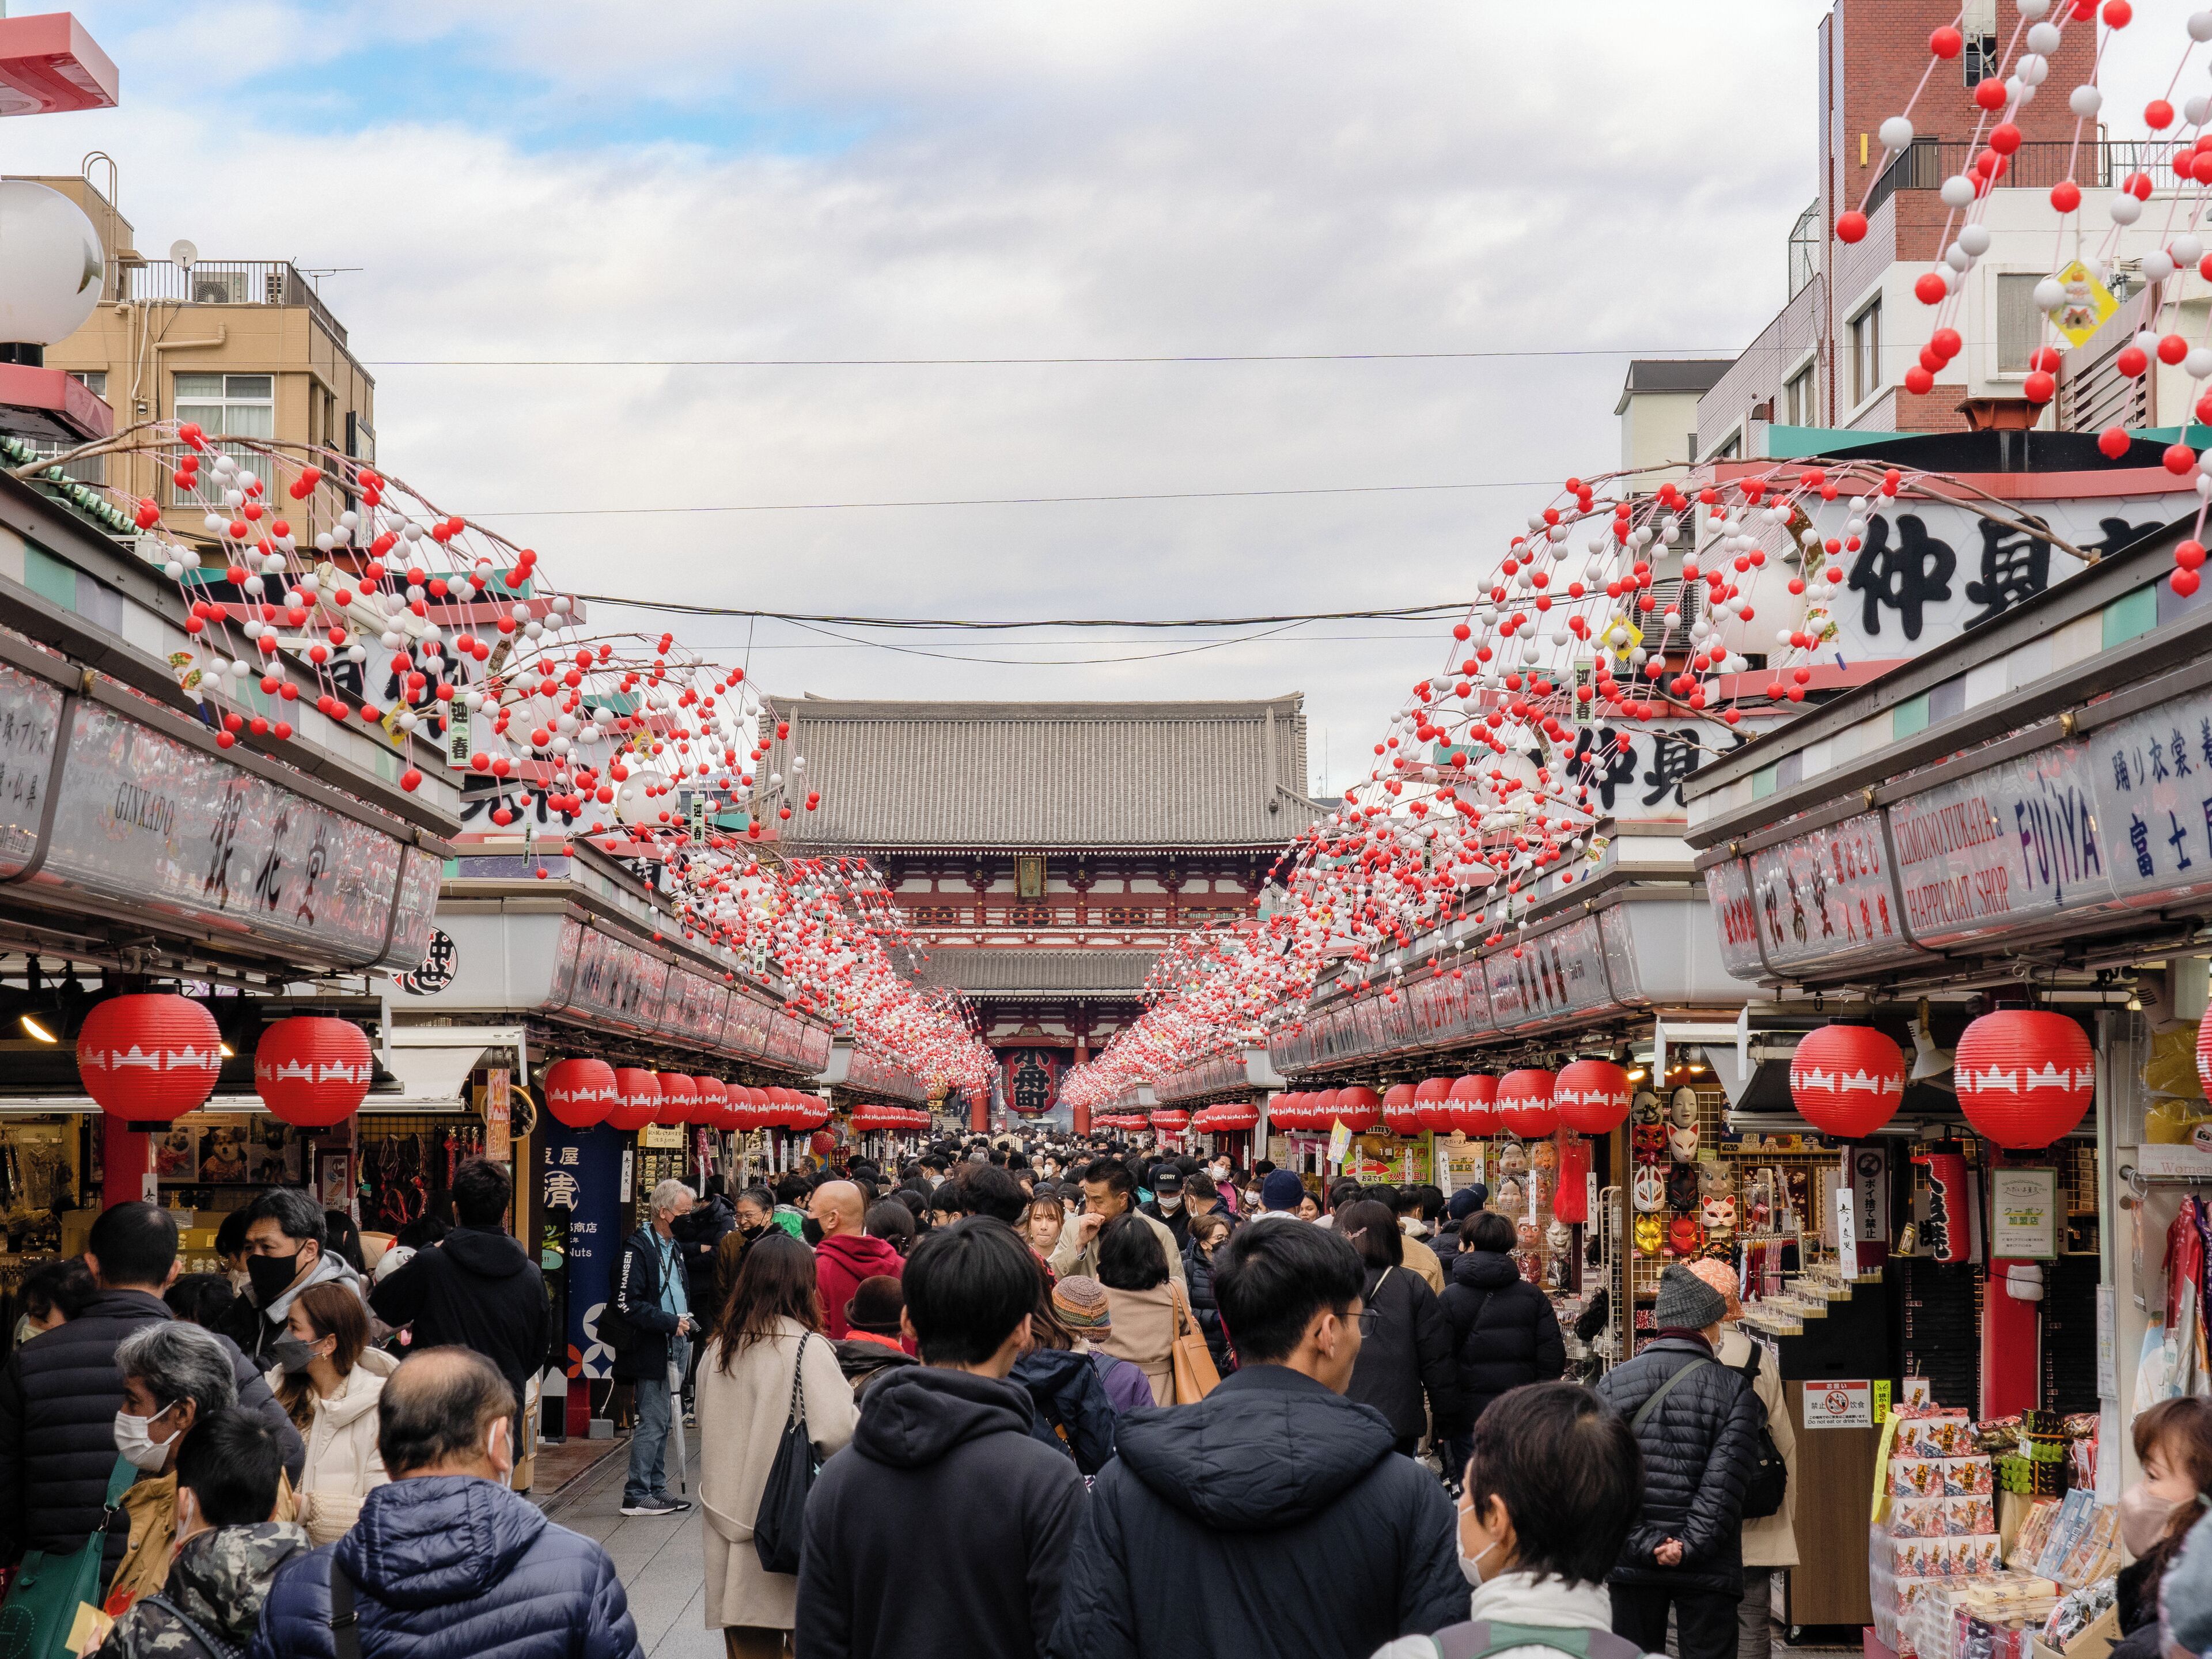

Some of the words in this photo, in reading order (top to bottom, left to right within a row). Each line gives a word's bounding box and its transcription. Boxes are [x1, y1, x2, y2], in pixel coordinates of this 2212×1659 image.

[1848, 513, 2166, 640] 仲見
[452, 702, 468, 759] 迎春
[116, 782, 175, 835] GINKADO
[694, 804, 702, 840] 迎春
[1013, 1050, 1051, 1110] 小舟町
[1865, 1179, 1876, 1238] ポイ捨て禁止
[2005, 1207, 2043, 1215] クーポン
[2009, 1216, 2039, 1225] 加盟店
[620, 1251, 632, 1289] HANSEN
[1810, 1402, 1825, 1410] 禁止
